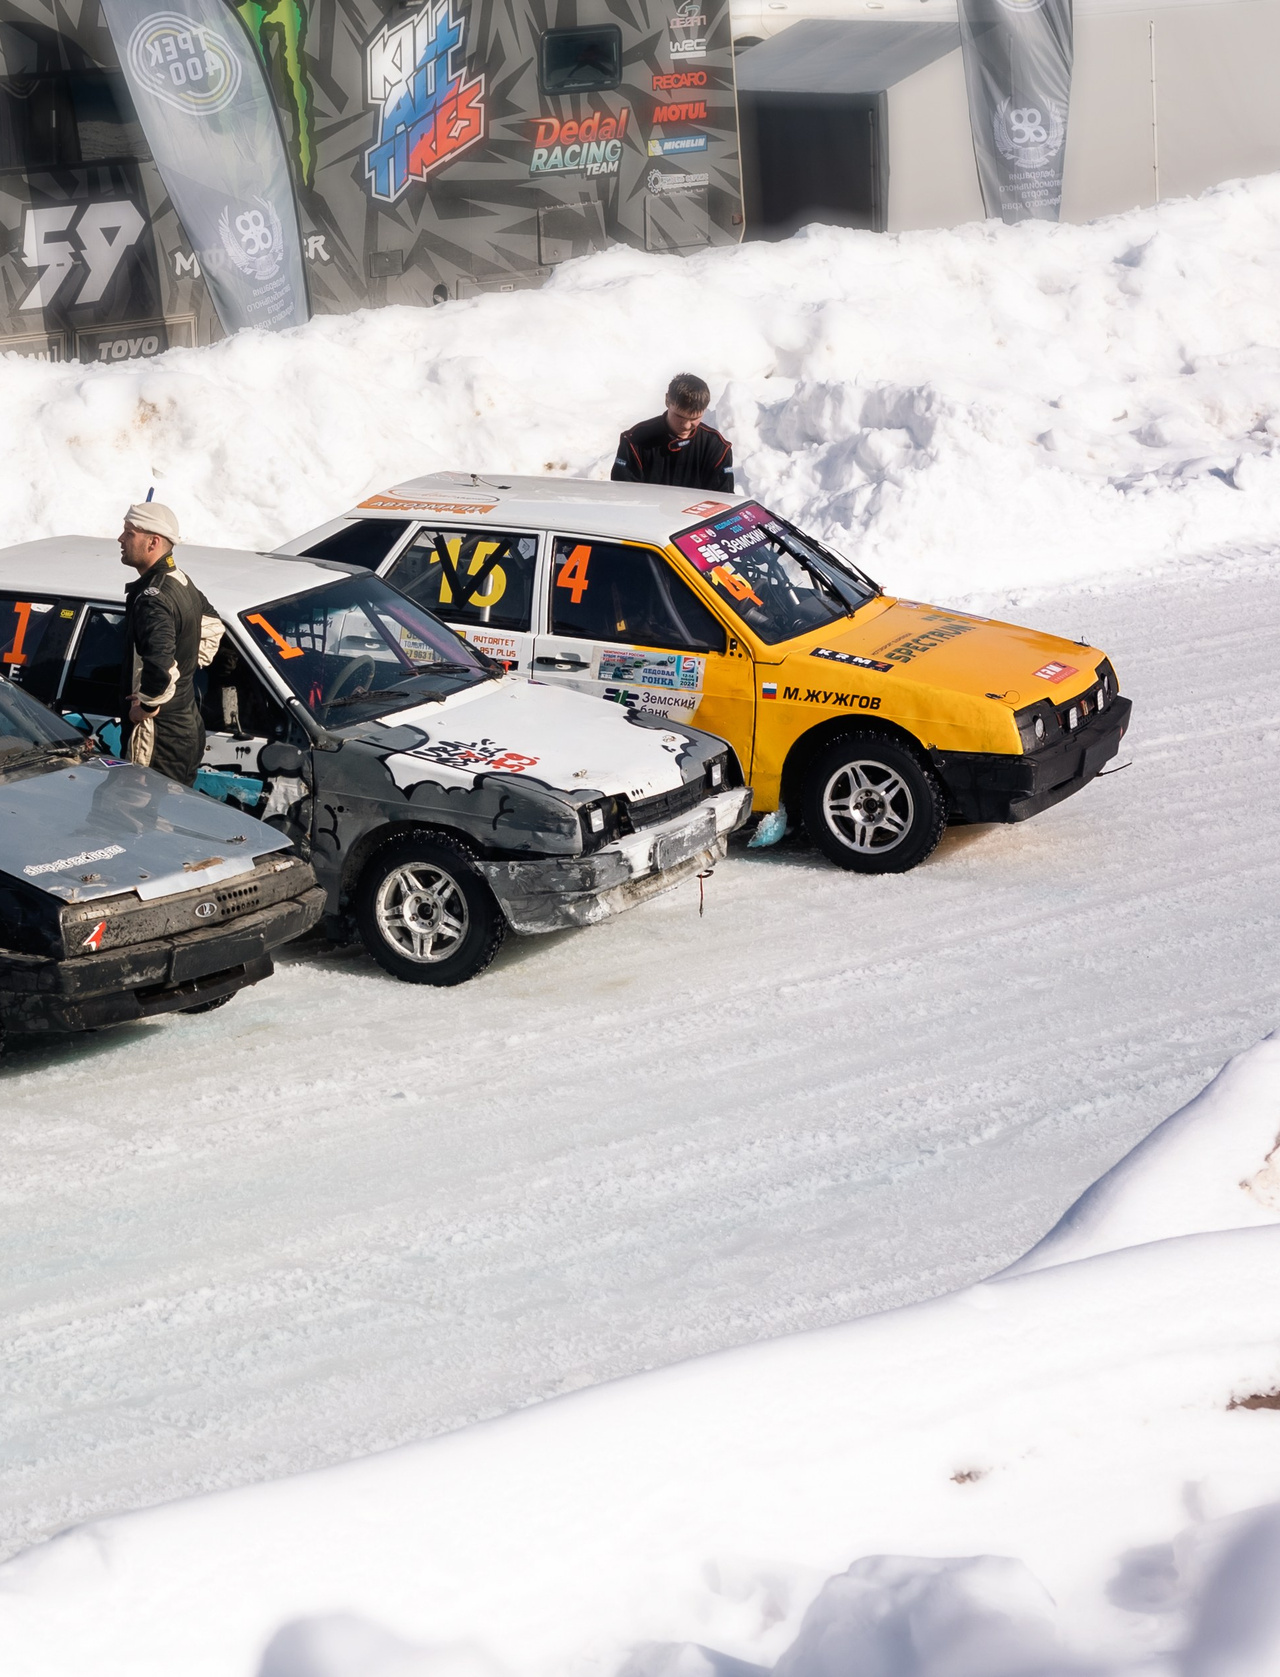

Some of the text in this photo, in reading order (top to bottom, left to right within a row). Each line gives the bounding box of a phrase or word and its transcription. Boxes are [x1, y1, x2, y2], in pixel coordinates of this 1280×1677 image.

[670, 39, 707, 52] WRC
[652, 71, 707, 91] RECARO
[653, 102, 707, 123] MOTUL
[529, 108, 629, 148] Dedal
[530, 139, 622, 171] RACING
[663, 138, 706, 151] MICHELIN
[586, 161, 619, 176] TEAM
[19, 200, 146, 311] 59
[99, 336, 159, 360] TOYO
[557, 545, 592, 603] 4
[712, 566, 764, 607] 4
[3, 602, 32, 664] 1
[246, 613, 305, 660] 1
[496, 648, 516, 658] PLUS
[641, 676, 674, 686] ГОНКА
[643, 668, 675, 677] ЛЕДОВАЯ
[642, 691, 696, 710] Земский
[783, 686, 882, 710] М.ЖУЖГОВ
